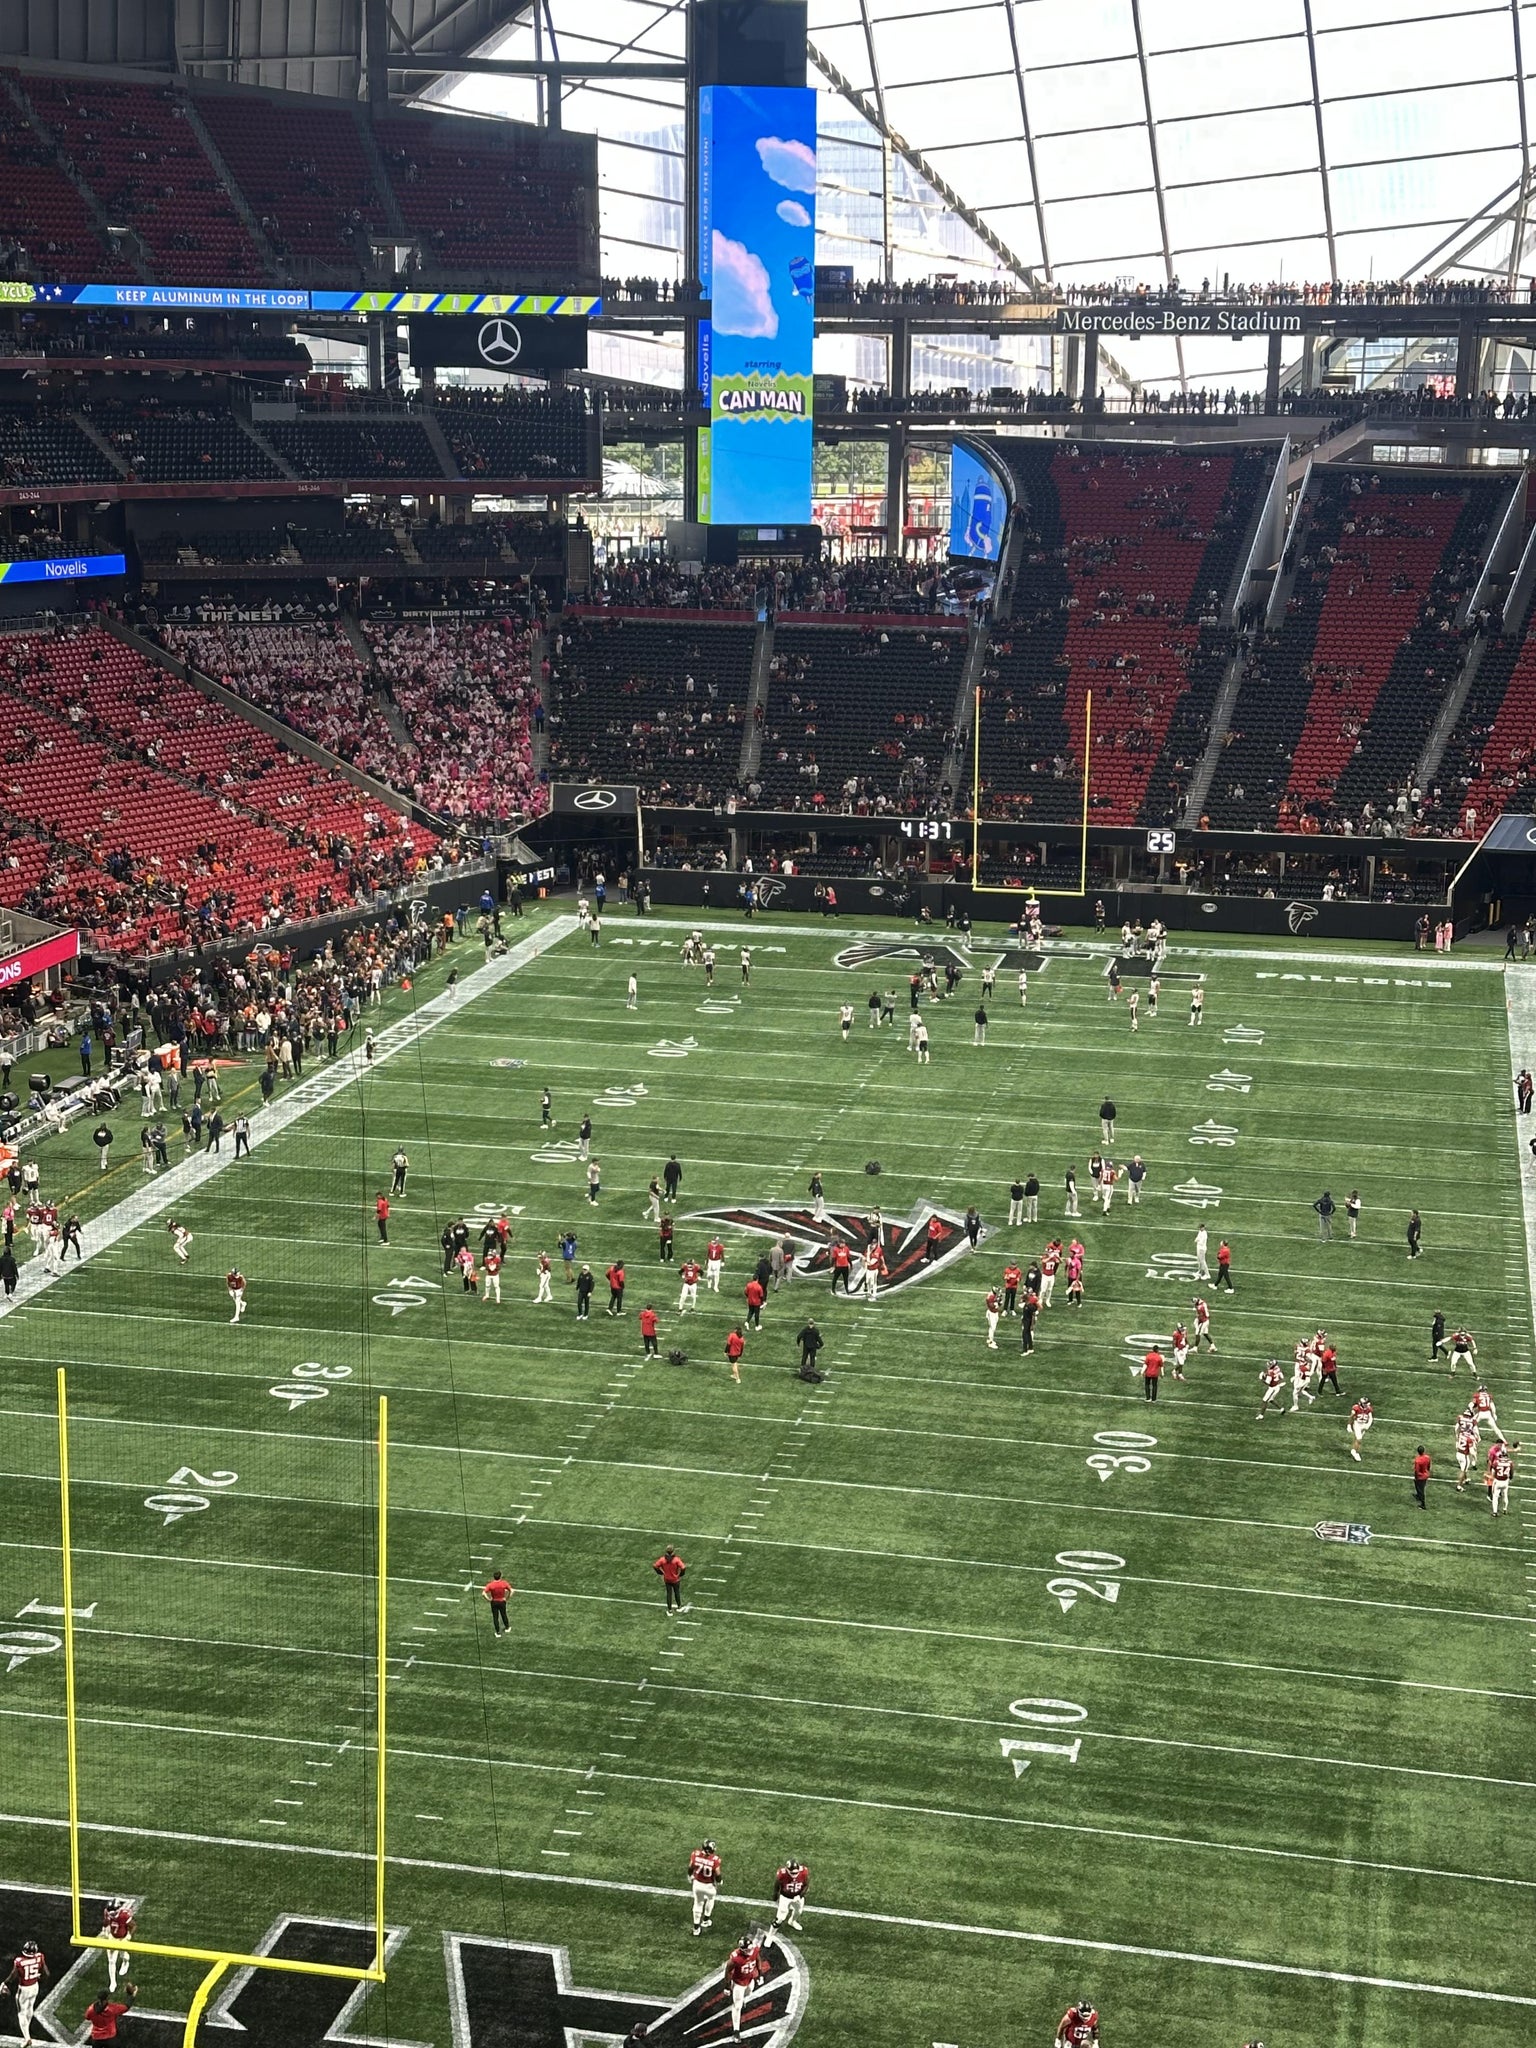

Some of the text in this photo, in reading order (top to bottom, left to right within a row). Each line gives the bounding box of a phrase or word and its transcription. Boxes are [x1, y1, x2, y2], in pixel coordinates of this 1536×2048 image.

[116, 290, 309, 306] KEEP ALUMINUM IN THE LOOP!
[1061, 311, 1302, 331] Mercedes-Benz Stadium
[701, 334, 710, 396] Novelis
[744, 360, 783, 370] starring
[718, 390, 803, 413] CAN MAN
[45, 560, 88, 577] Novelis
[201, 610, 282, 623] THE NEST
[1149, 832, 1173, 851] 25
[609, 938, 787, 953] ATLNTA
[1256, 972, 1452, 988] FALCONS
[694, 997, 743, 1014] 10
[1221, 1027, 1265, 1045] 10
[646, 1038, 699, 1058] 20
[1205, 1073, 1253, 1094] 20
[592, 1084, 649, 1106] 30
[1188, 1124, 1239, 1147] 30
[1169, 1184, 1224, 1209] 40
[371, 1274, 443, 1307] 40
[268, 1362, 353, 1400] 30
[1085, 1430, 1158, 1473] 30
[143, 1466, 239, 1513] 20
[1046, 1550, 1127, 1603] 20
[0, 1598, 99, 1655] 10
[999, 1698, 1089, 1764] 10
[694, 1864, 712, 1877] 70
